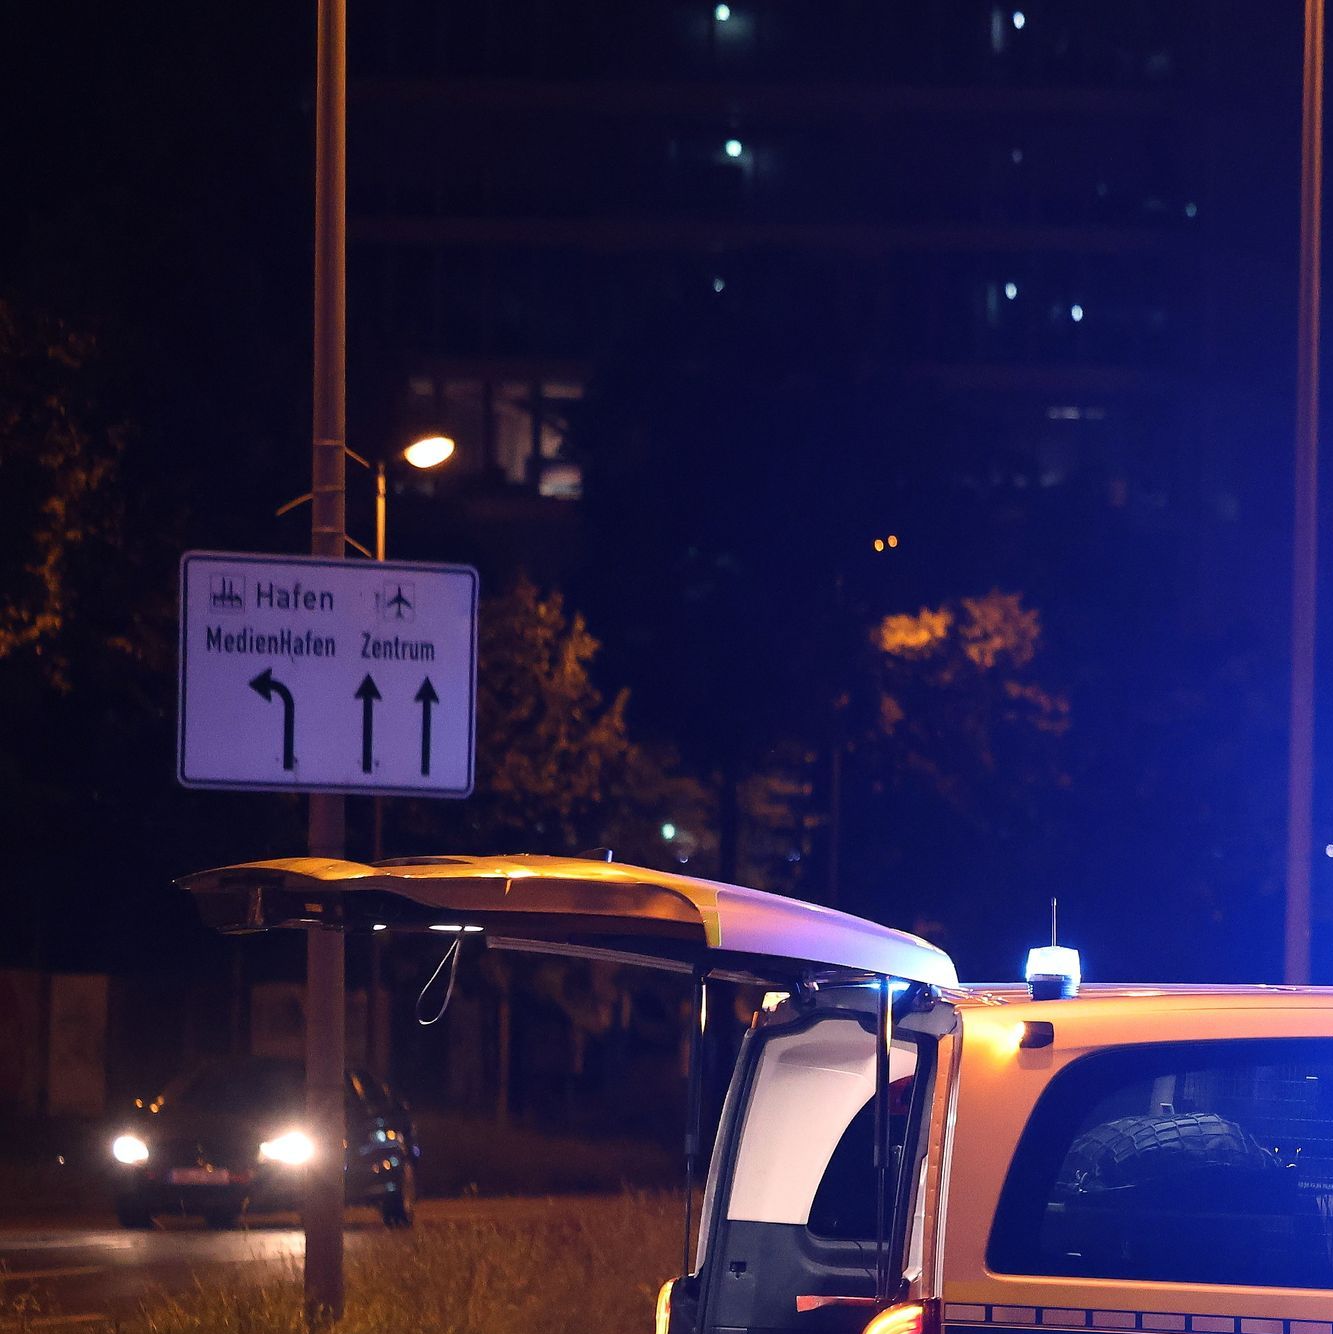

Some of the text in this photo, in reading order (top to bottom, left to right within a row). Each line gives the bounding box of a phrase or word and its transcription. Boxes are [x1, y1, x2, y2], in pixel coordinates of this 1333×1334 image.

[256, 580, 334, 611] Hafen
[206, 625, 336, 657] MedienHafen
[361, 631, 435, 661] Zentrum
